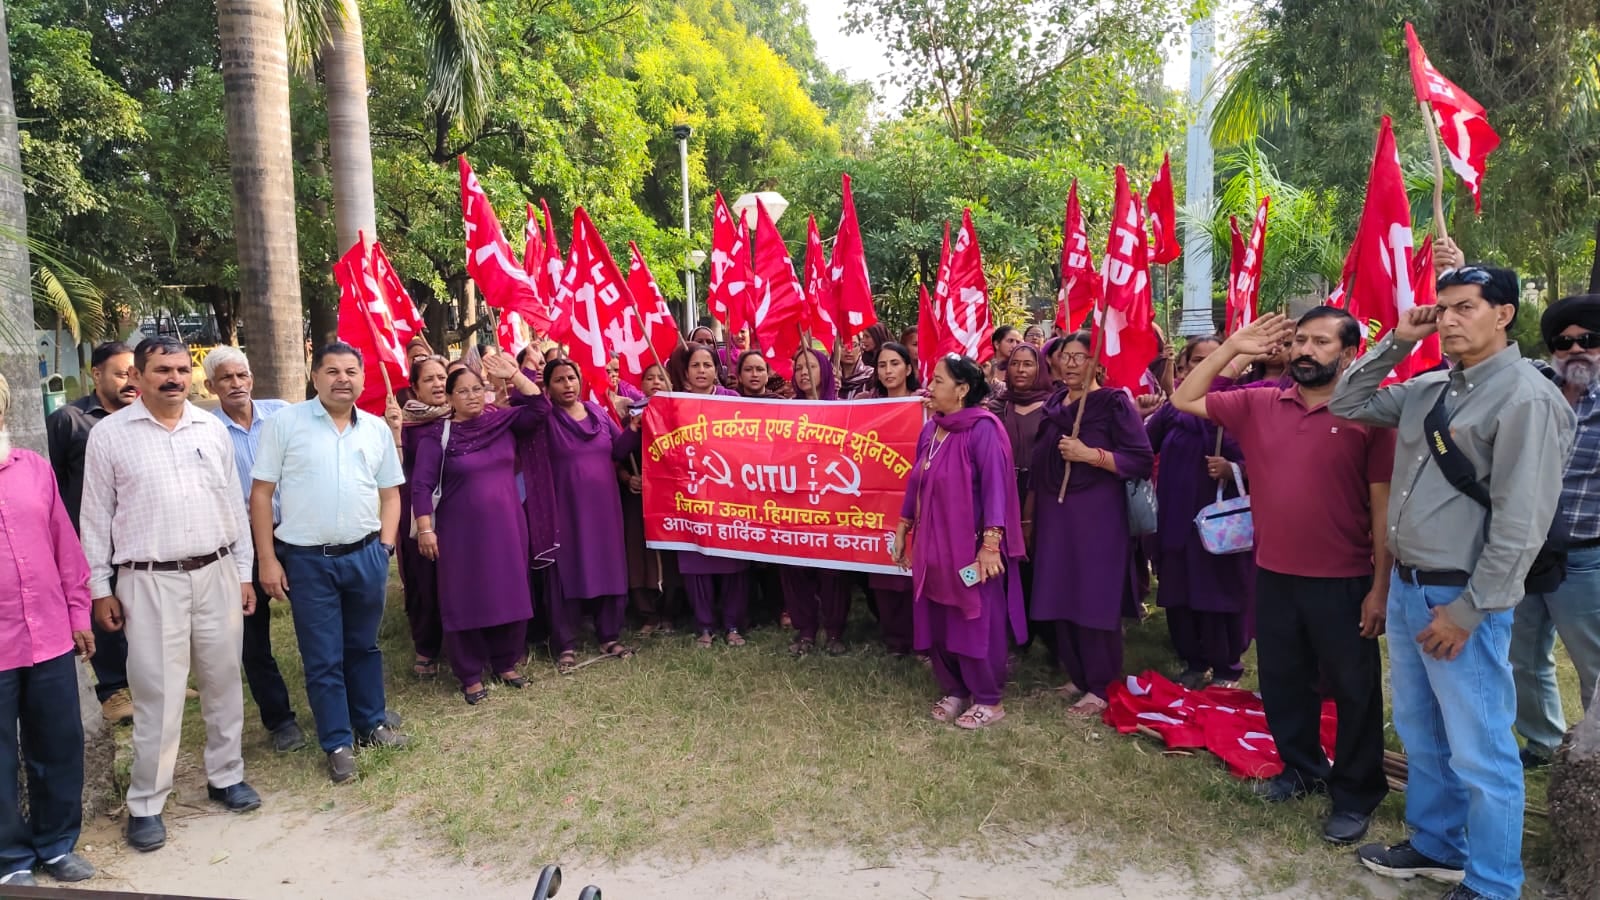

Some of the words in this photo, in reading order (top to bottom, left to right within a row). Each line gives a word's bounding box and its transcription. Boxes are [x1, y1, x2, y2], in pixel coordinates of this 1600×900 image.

[765, 418, 795, 442] एण्ड
[851, 430, 913, 479] यूनियन
[741, 463, 797, 494] CITU
[675, 491, 715, 516] जिला
[835, 505, 885, 529] प्रदेश
[662, 517, 713, 537] आपका
[716, 519, 767, 542] हार्दिक
[770, 529, 829, 548] स्वागत
[833, 534, 880, 553] करता
